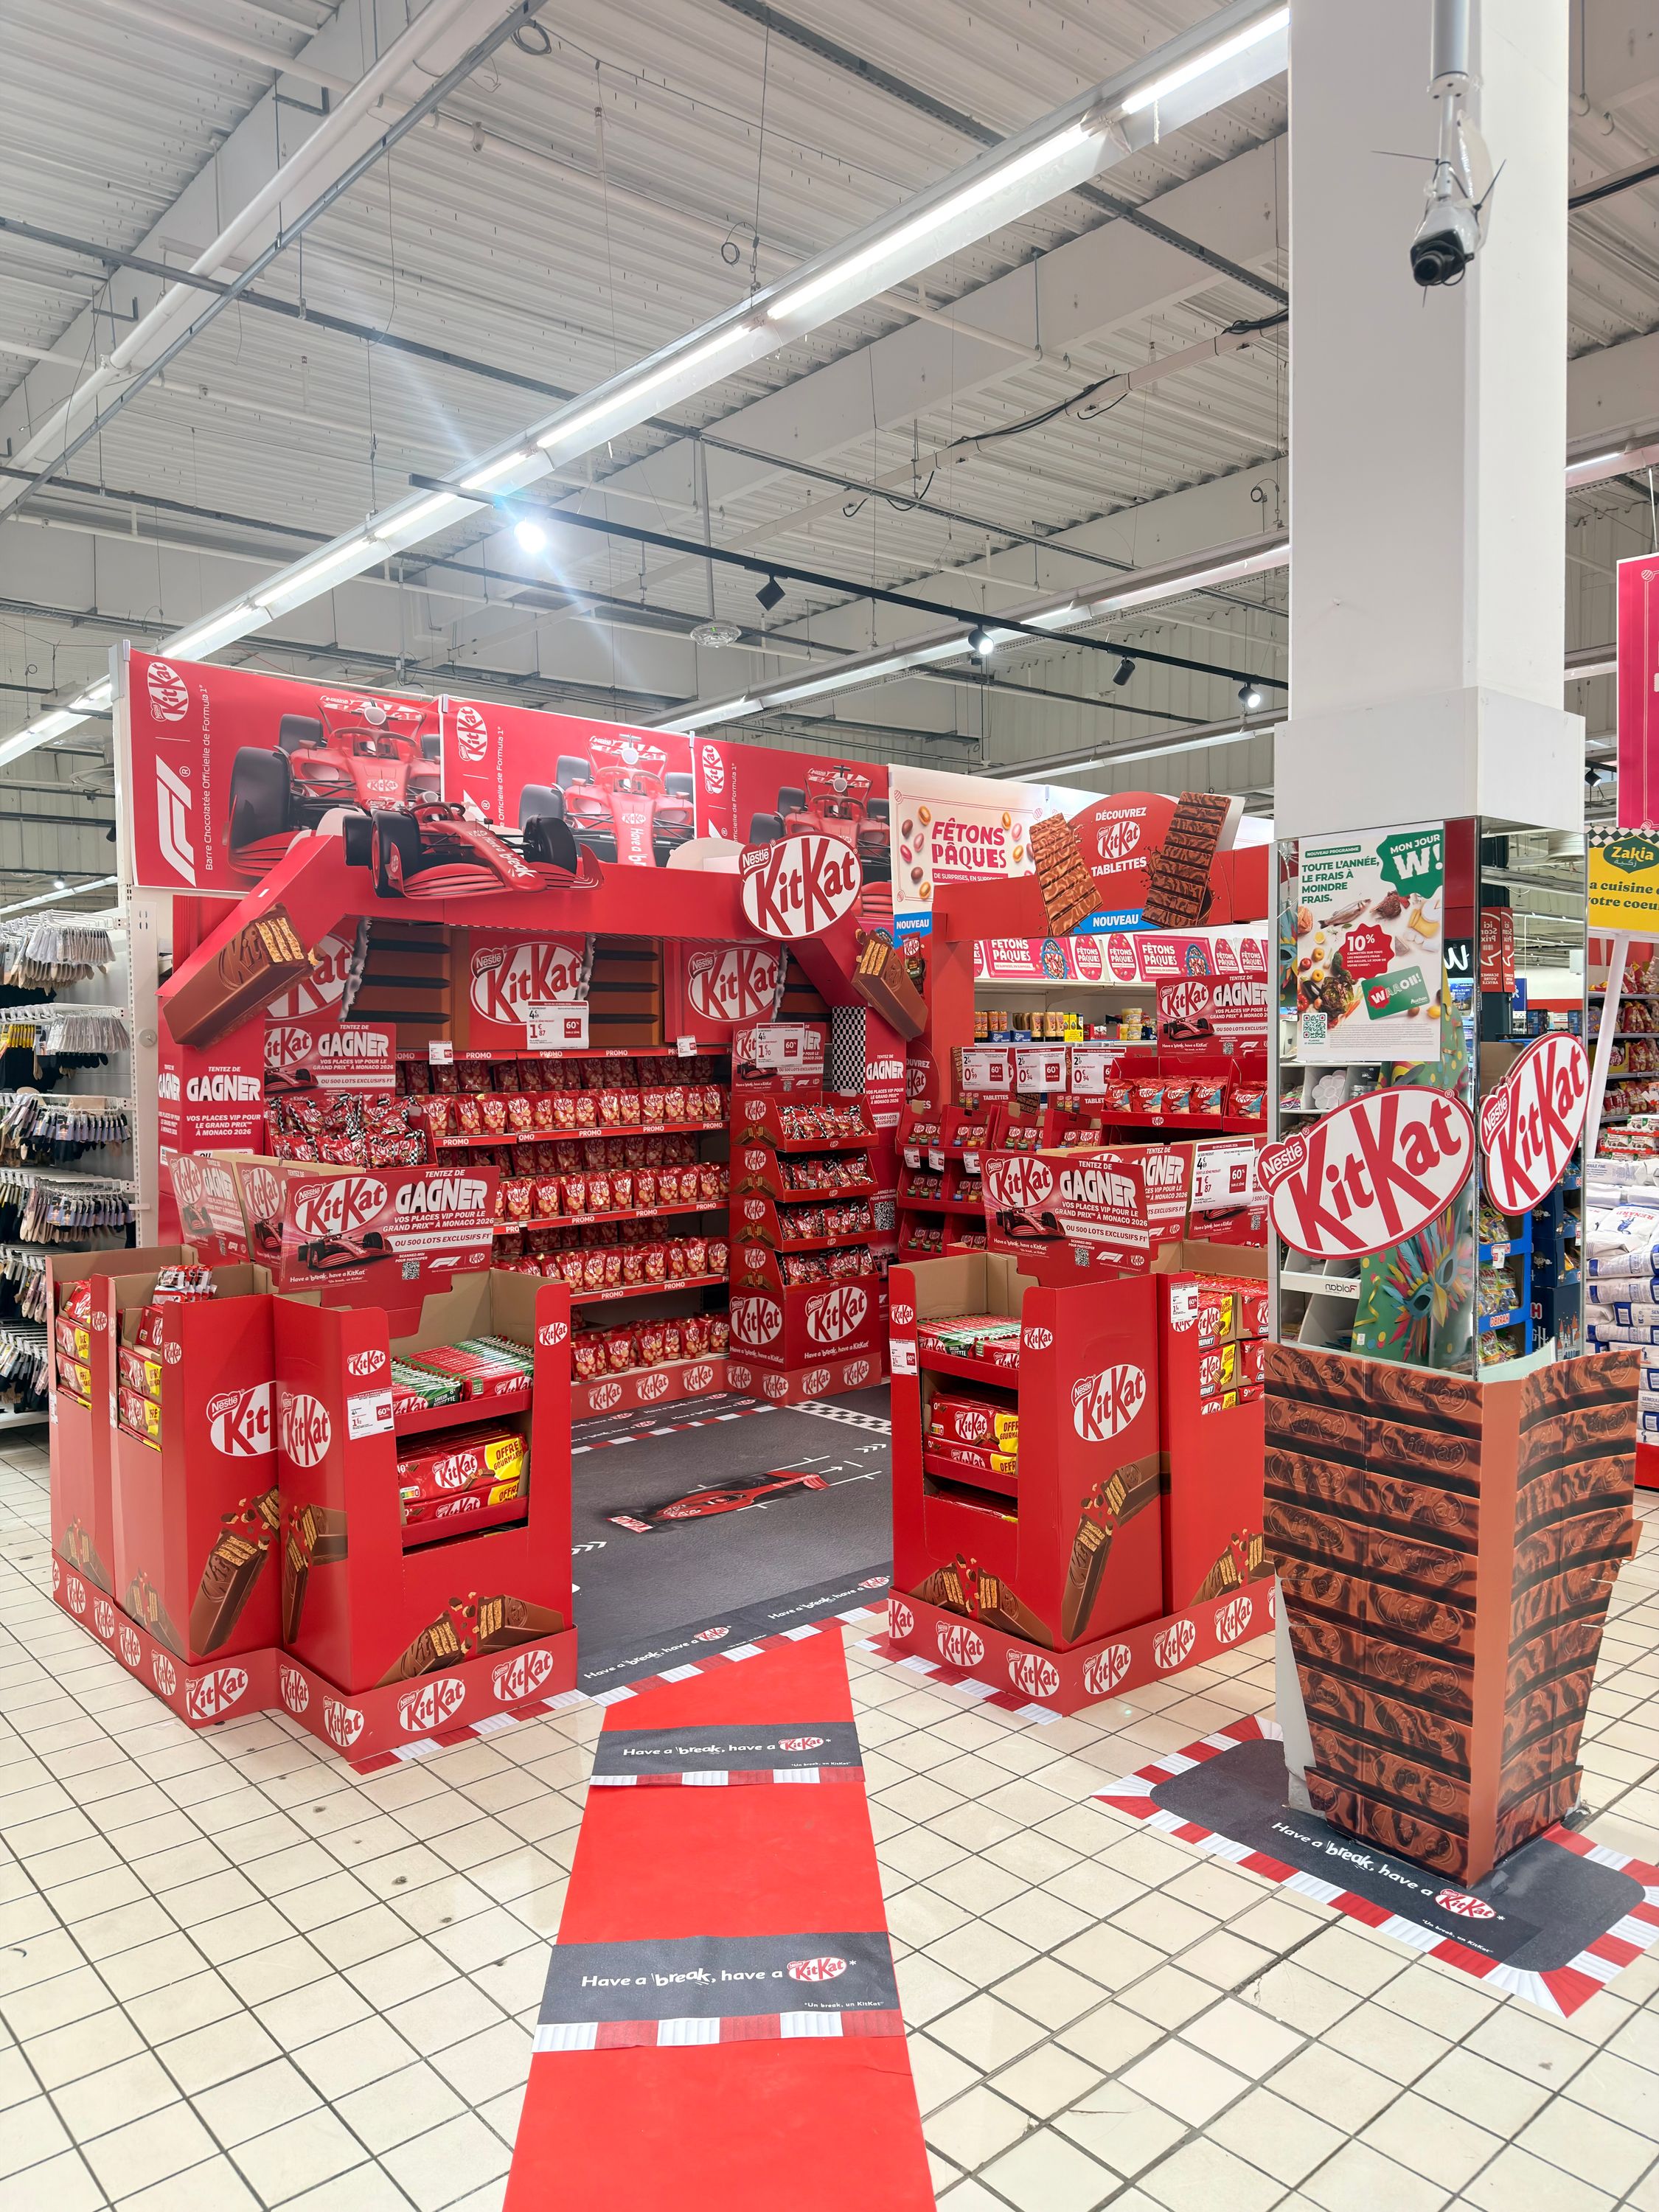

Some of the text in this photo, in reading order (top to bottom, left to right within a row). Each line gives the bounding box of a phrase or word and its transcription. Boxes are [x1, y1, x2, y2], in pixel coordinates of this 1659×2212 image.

[147, 663, 187, 715] KitKat
[202, 733, 209, 741] de
[457, 708, 487, 757] KitKat
[202, 743, 211, 788] Officielle
[703, 745, 724, 792] KitKat
[497, 772, 503, 782] de
[1096, 807, 1147, 821] DÉCOUVREZ
[932, 818, 1004, 846] FÊTONS
[1102, 822, 1138, 858] KitKat
[1390, 834, 1440, 854] MON JOUR
[1611, 846, 1654, 862] Zakia
[742, 848, 770, 869] Nestlé
[932, 842, 1006, 869] PÂQUES
[1393, 843, 1443, 880] W!
[1091, 857, 1147, 877] TABLETTES
[1302, 862, 1333, 872] TOUTE
[1315, 872, 1343, 882] FRAIS
[1346, 869, 1354, 878] À
[757, 835, 856, 935] KitKat
[1301, 882, 1347, 894] MOINDRE
[1601, 881, 1652, 894] cuisine
[1301, 894, 1332, 904] FRAIS.
[896, 918, 930, 929] NOUVEAU
[1093, 914, 1138, 927] NOUVEAU
[1142, 943, 1175, 954] FÊTONS
[1347, 933, 1374, 952] 10%
[476, 953, 501, 970] Nestlé
[692, 957, 714, 970] Nestlé
[993, 947, 1031, 962] PÂQUES
[1144, 953, 1176, 966] PÂQUES
[487, 944, 581, 1023] KitKat
[701, 950, 777, 1019] KitKat
[1167, 983, 1206, 1017] KitKat
[319, 1032, 389, 1057] GAGNER
[187, 1074, 260, 1102] GAGNER
[1481, 1093, 1508, 1133] Nestlé
[579, 1129, 602, 1137] PROMO
[1498, 1040, 1582, 1207] KitKat
[442, 1138, 469, 1146] PROMO
[1079, 1161, 1102, 1169] TENTEZ
[1262, 1141, 1303, 1177] Nestlé
[995, 1158, 1050, 1206] KitKat
[1287, 1094, 1462, 1251] KitKat
[299, 1188, 320, 1200] Nestlé
[395, 1178, 487, 1214] GAGNER
[1060, 1169, 1137, 1208] GAGNER
[305, 1179, 383, 1234] KitKat
[696, 1202, 717, 1210] PROMO
[411, 1214, 439, 1222] PLACES
[571, 1216, 595, 1224] PROMO
[442, 1234, 481, 1242] EXCLUSIFS
[1105, 1230, 1138, 1240] EXCLUSIFS
[1074, 1380, 1093, 1397] Nestlé
[1082, 1366, 1144, 1439] KitKat
[284, 1397, 330, 1466] KitKat
[496, 1441, 519, 1461] OFFRE
[440, 1455, 476, 1487] KitKat
[498, 1652, 553, 1700] KitKat
[1087, 1646, 1130, 1693] KitKat
[402, 1681, 464, 1730] KitKat
[728, 1744, 762, 1752] have
[1271, 1822, 1311, 1843] Have
[1311, 1840, 1323, 1848] a
[1378, 1864, 1419, 1890] have
[1421, 1888, 1433, 1896] a
[581, 1975, 630, 1987] Have
[635, 1976, 647, 1985] a
[721, 1969, 765, 1981] have
[771, 1969, 782, 1979] a
